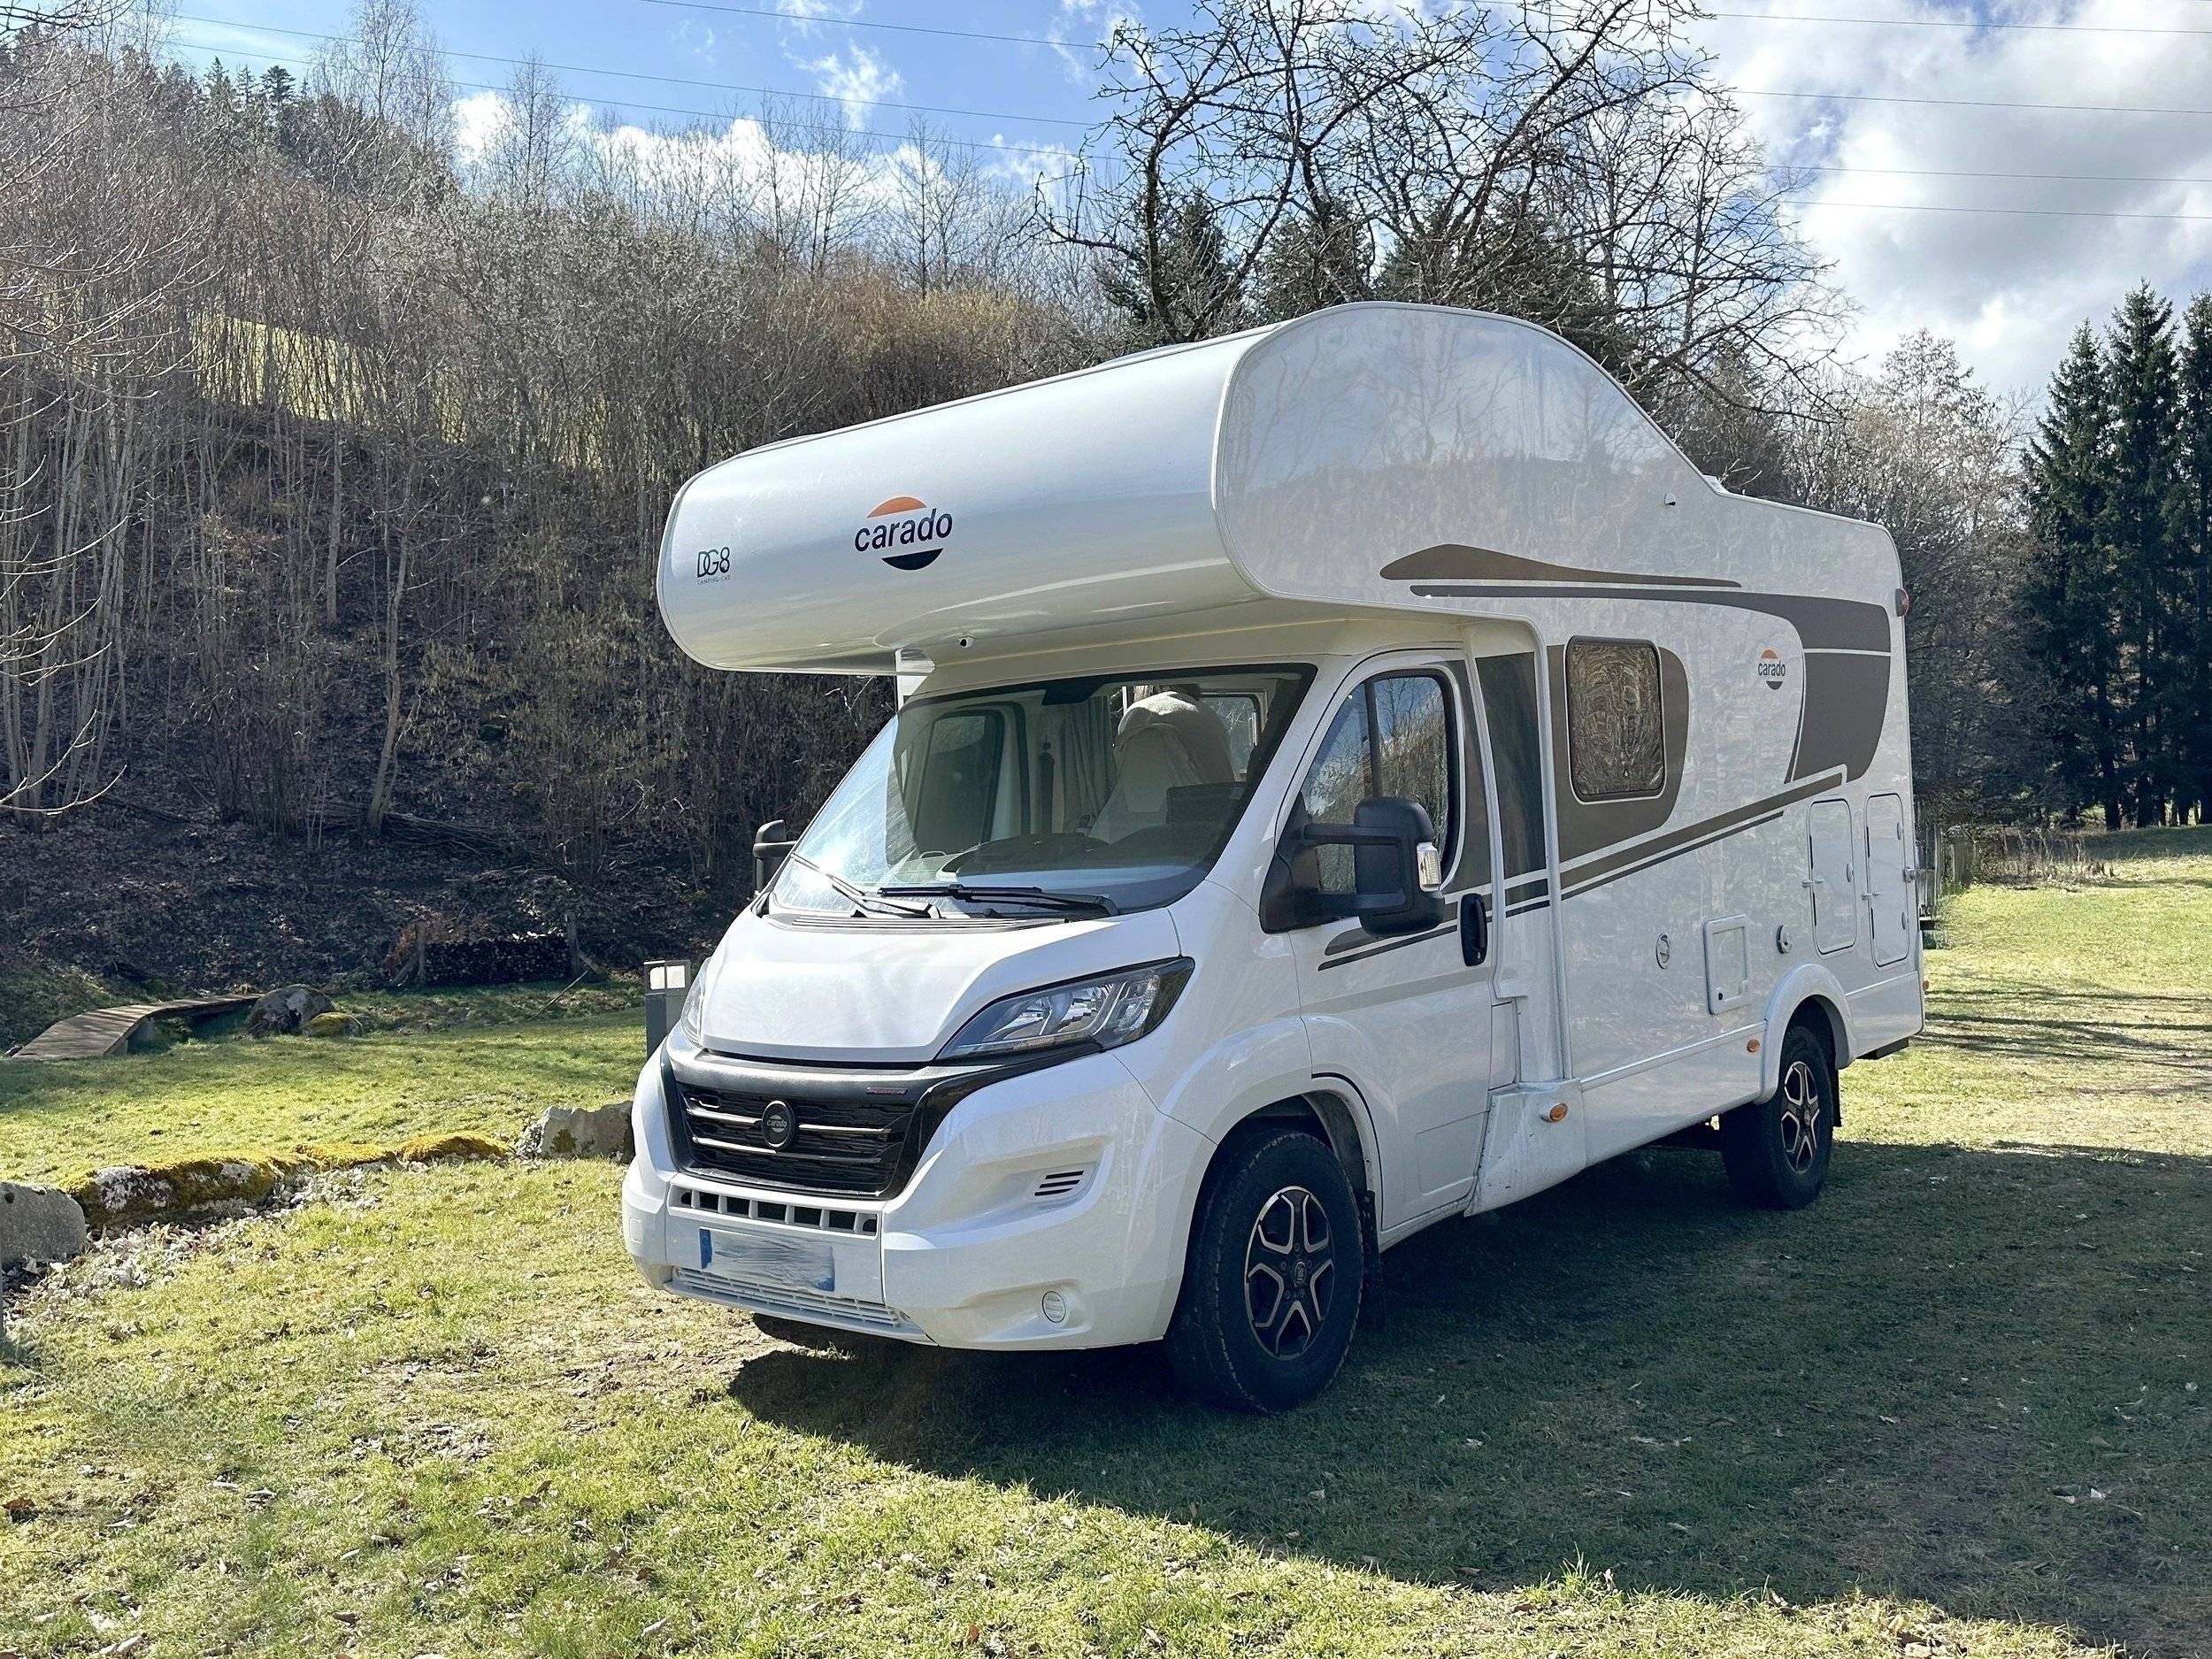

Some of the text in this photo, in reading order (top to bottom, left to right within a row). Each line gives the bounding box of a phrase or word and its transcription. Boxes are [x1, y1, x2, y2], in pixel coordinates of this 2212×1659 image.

[854, 507, 953, 552] carado
[697, 546, 730, 578] DG8
[1757, 659, 1786, 677] carado
